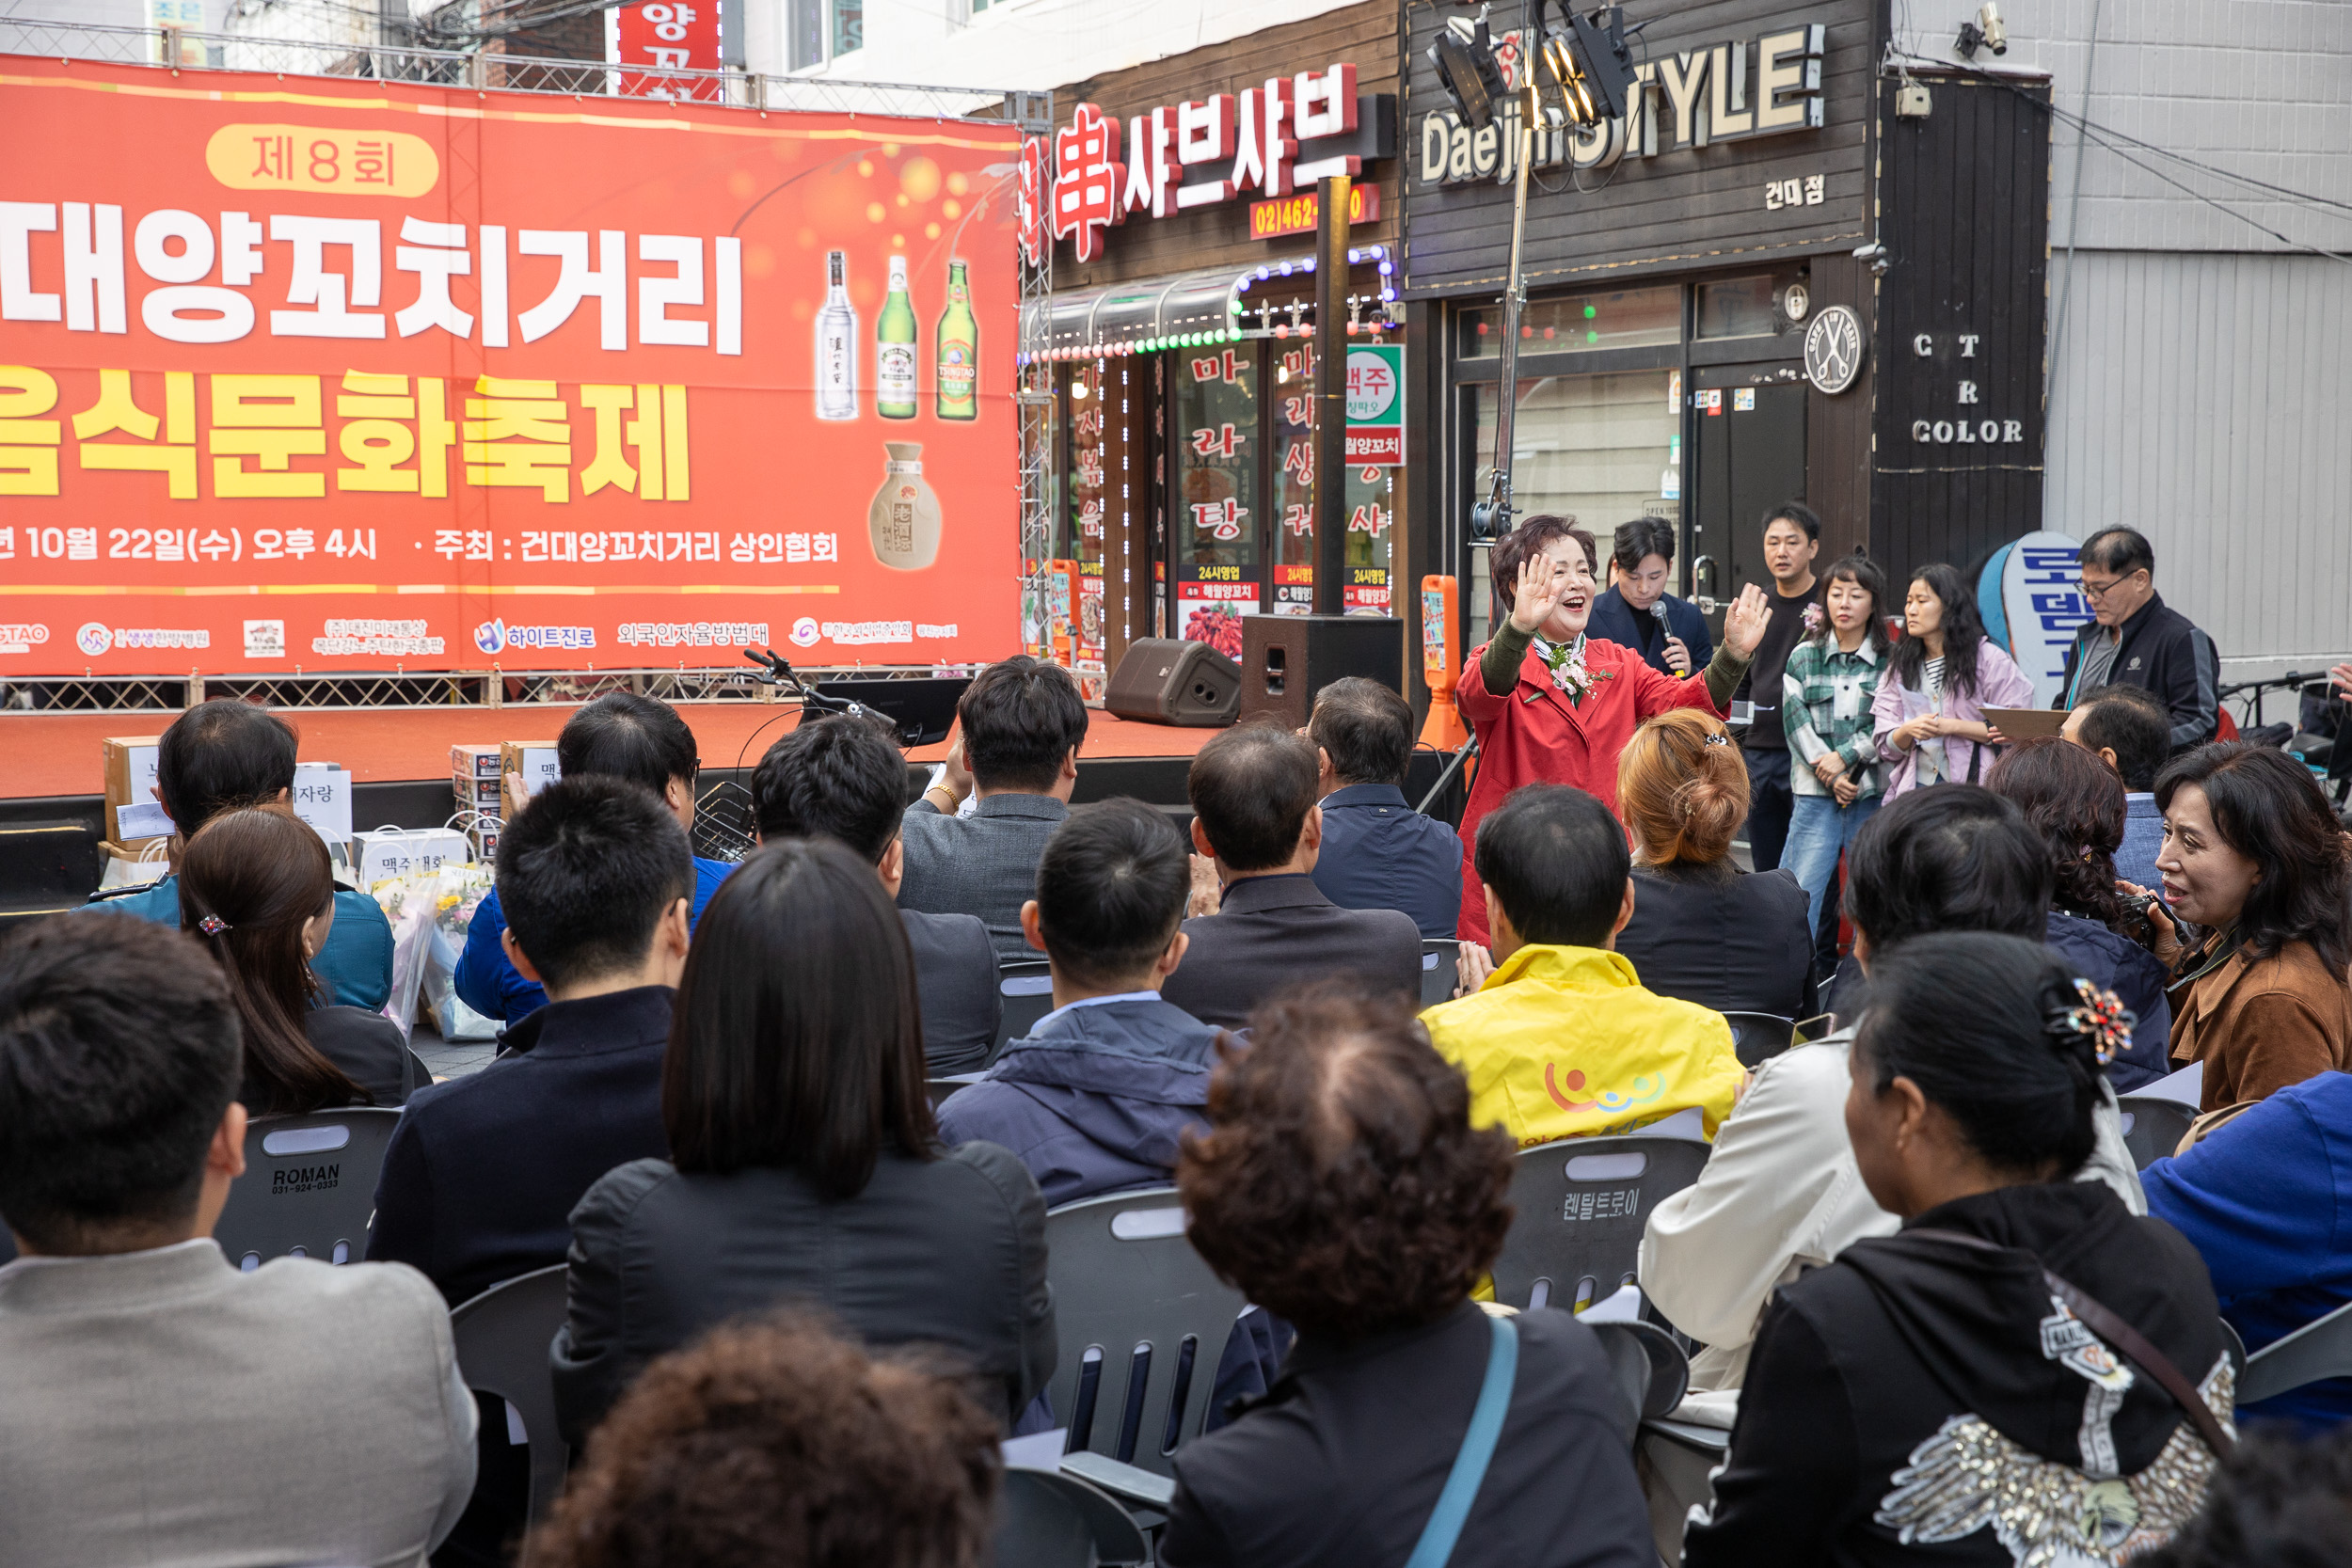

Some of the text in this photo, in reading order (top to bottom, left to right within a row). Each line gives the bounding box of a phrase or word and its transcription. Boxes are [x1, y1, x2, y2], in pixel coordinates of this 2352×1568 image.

[1122, 62, 1357, 219] 샤브샤브
[1765, 174, 1825, 211] 건대점
[1912, 420, 2024, 443] COLOR
[1189, 348, 1250, 541] 마라탕
[25, 526, 98, 560] 10월
[108, 528, 243, 562] 22일(수)
[253, 528, 316, 560] 오후
[325, 529, 377, 561] 4시
[435, 530, 493, 562] 주최
[521, 531, 721, 562] 건대양꼬치거리
[729, 532, 837, 562] 상인협회
[1198, 565, 1241, 581] 24시영업
[1354, 569, 1386, 585] 24시영업
[1202, 584, 1252, 600] 해월양꼬치
[509, 628, 594, 646] 하이트진로
[619, 625, 769, 645] 외국인자율방범대
[541, 763, 561, 780] 맥
[273, 1164, 340, 1185] ROMAN
[272, 1180, 339, 1195] 031-924-0333
[1564, 1188, 1640, 1220] 렌탈트로이
